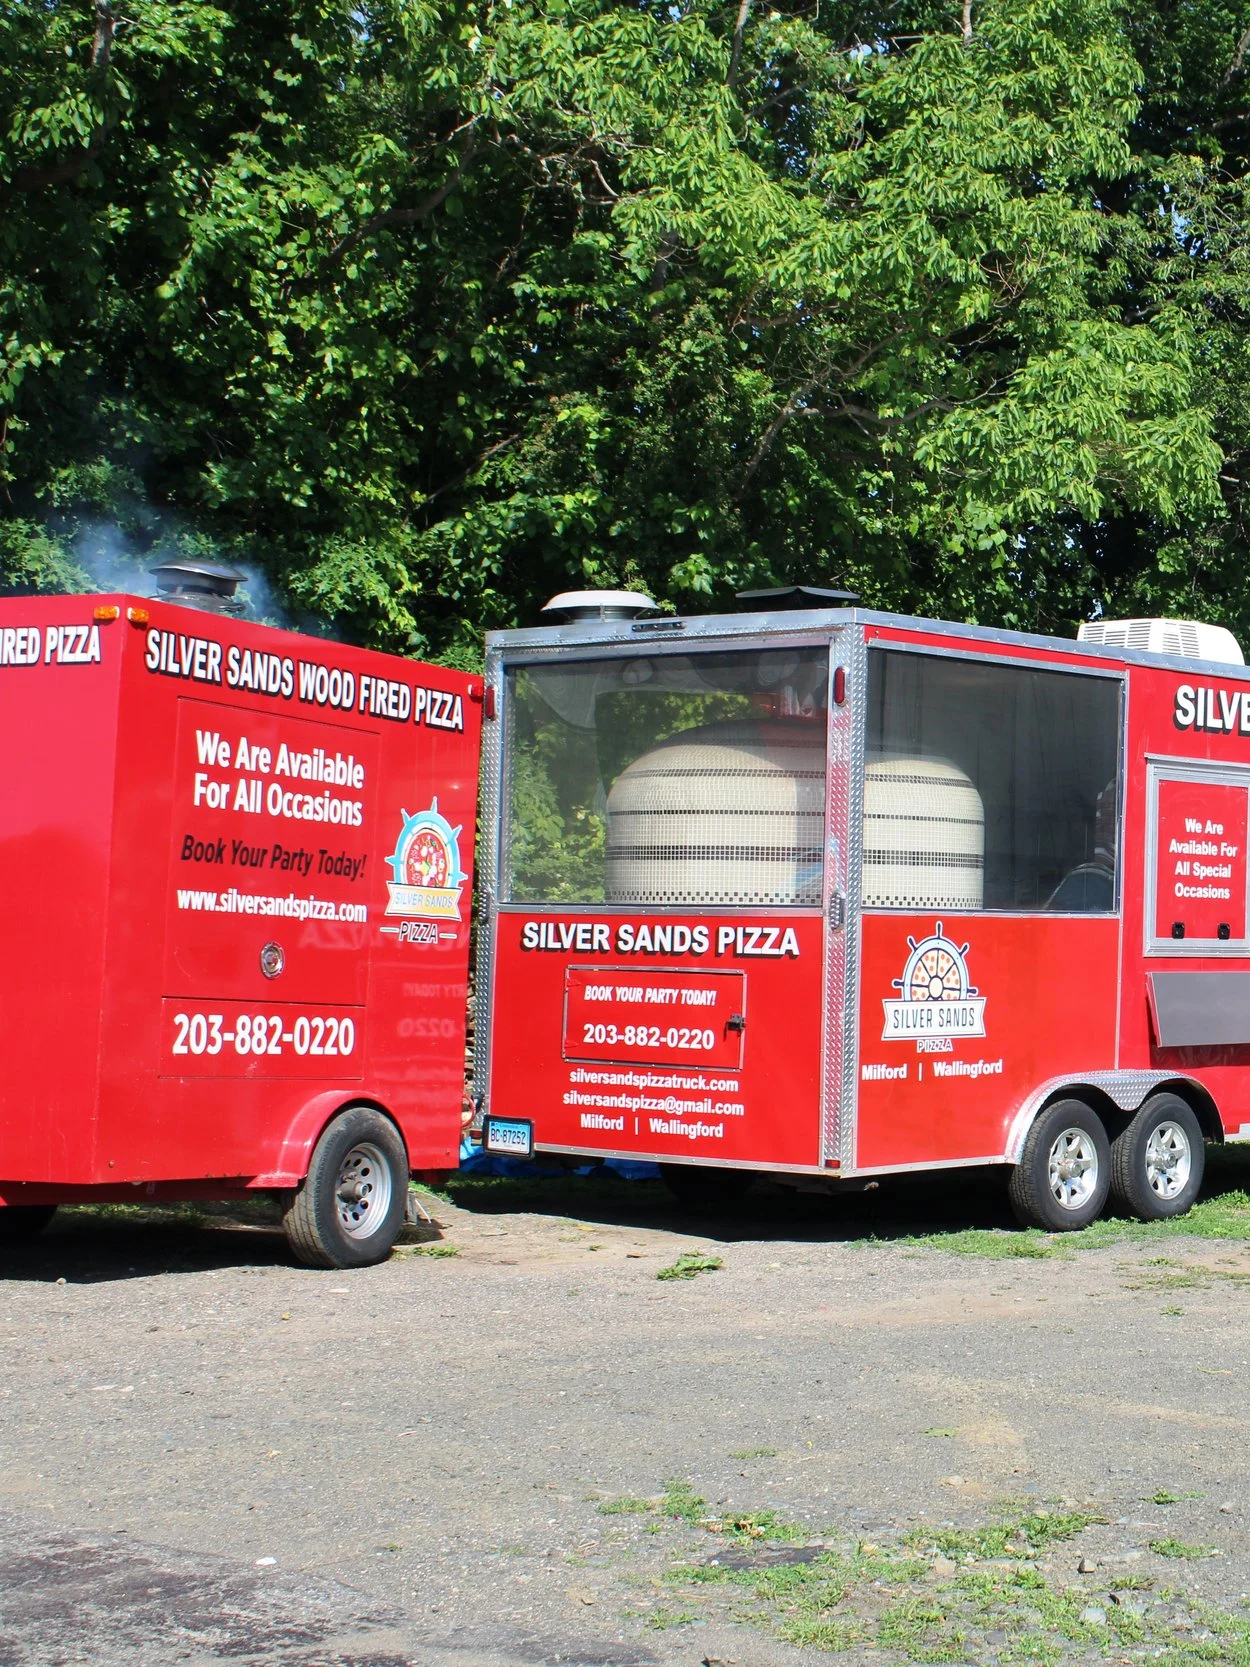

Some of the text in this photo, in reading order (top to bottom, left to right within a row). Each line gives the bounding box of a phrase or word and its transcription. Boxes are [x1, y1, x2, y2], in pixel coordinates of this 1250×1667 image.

[45, 625, 101, 664] PIZZA
[145, 628, 464, 733] SILVER SANDS WOOD FIRED PIZZA
[196, 730, 364, 788] We Are Available
[194, 773, 362, 827] For All Occasions
[1185, 818, 1224, 835] We Are
[180, 835, 367, 882] Book Your Party Today!
[1169, 839, 1238, 857] Available For
[1174, 861, 1231, 880] All Special
[395, 892, 453, 908] SILVER SANDS
[1174, 882, 1230, 899] Occasions
[177, 888, 367, 922] www.silversandspizza.com
[399, 921, 438, 943] PIZZA
[521, 922, 800, 957] SILVER SANDS PIZZA
[584, 986, 717, 1006] BOOK YOUR PARTY TODAY!
[893, 1007, 975, 1028] SILVER SANDS
[173, 1014, 355, 1055] 203-882-0220
[583, 1023, 715, 1050] 203-882-0220
[917, 1039, 953, 1053] PIZZA
[570, 1068, 739, 1092] silversandspizzatruck.com
[861, 1063, 907, 1080] Milford
[933, 1059, 1003, 1078] Wallingford
[563, 1091, 744, 1115] silversandspizza@gmail.com
[581, 1114, 623, 1130] Milford
[649, 1118, 723, 1139] Wallingford
